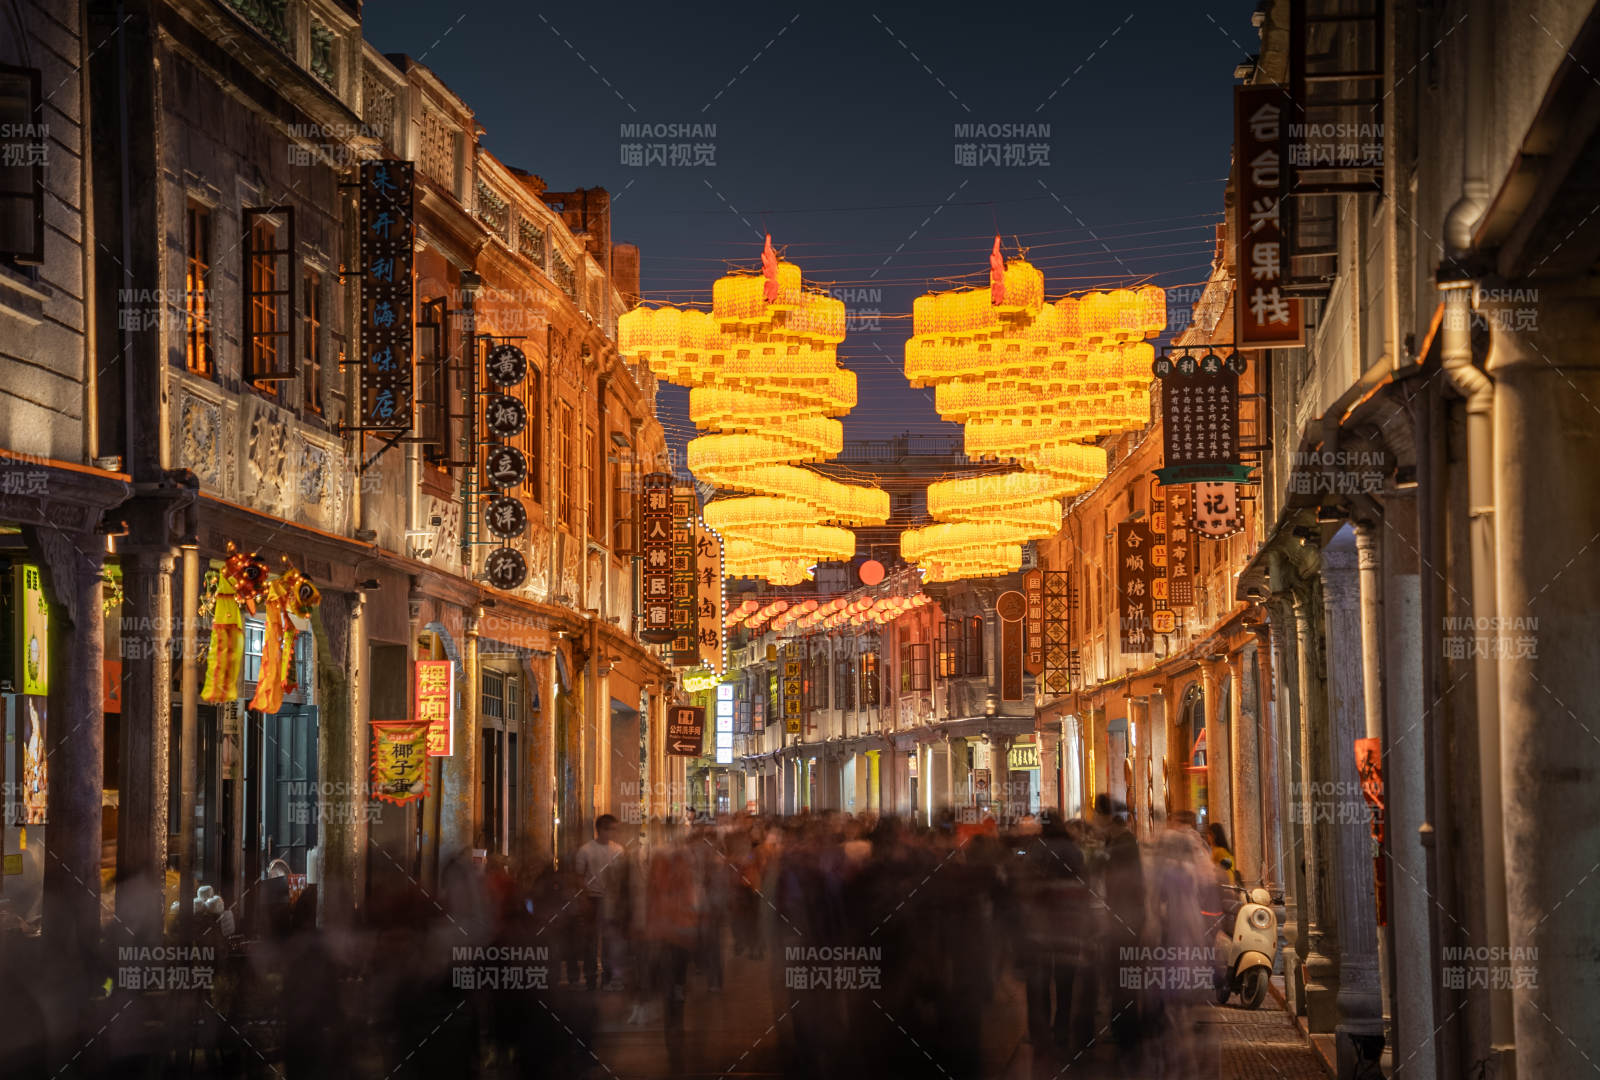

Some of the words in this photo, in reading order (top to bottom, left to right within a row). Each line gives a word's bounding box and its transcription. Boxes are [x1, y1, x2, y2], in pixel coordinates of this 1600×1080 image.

[1203, 483, 1229, 515] 记
[649, 493, 667, 624] 和人林民宿
[669, 724, 702, 736] 公共洗手间
[390, 743, 414, 793] 椰子蛋
